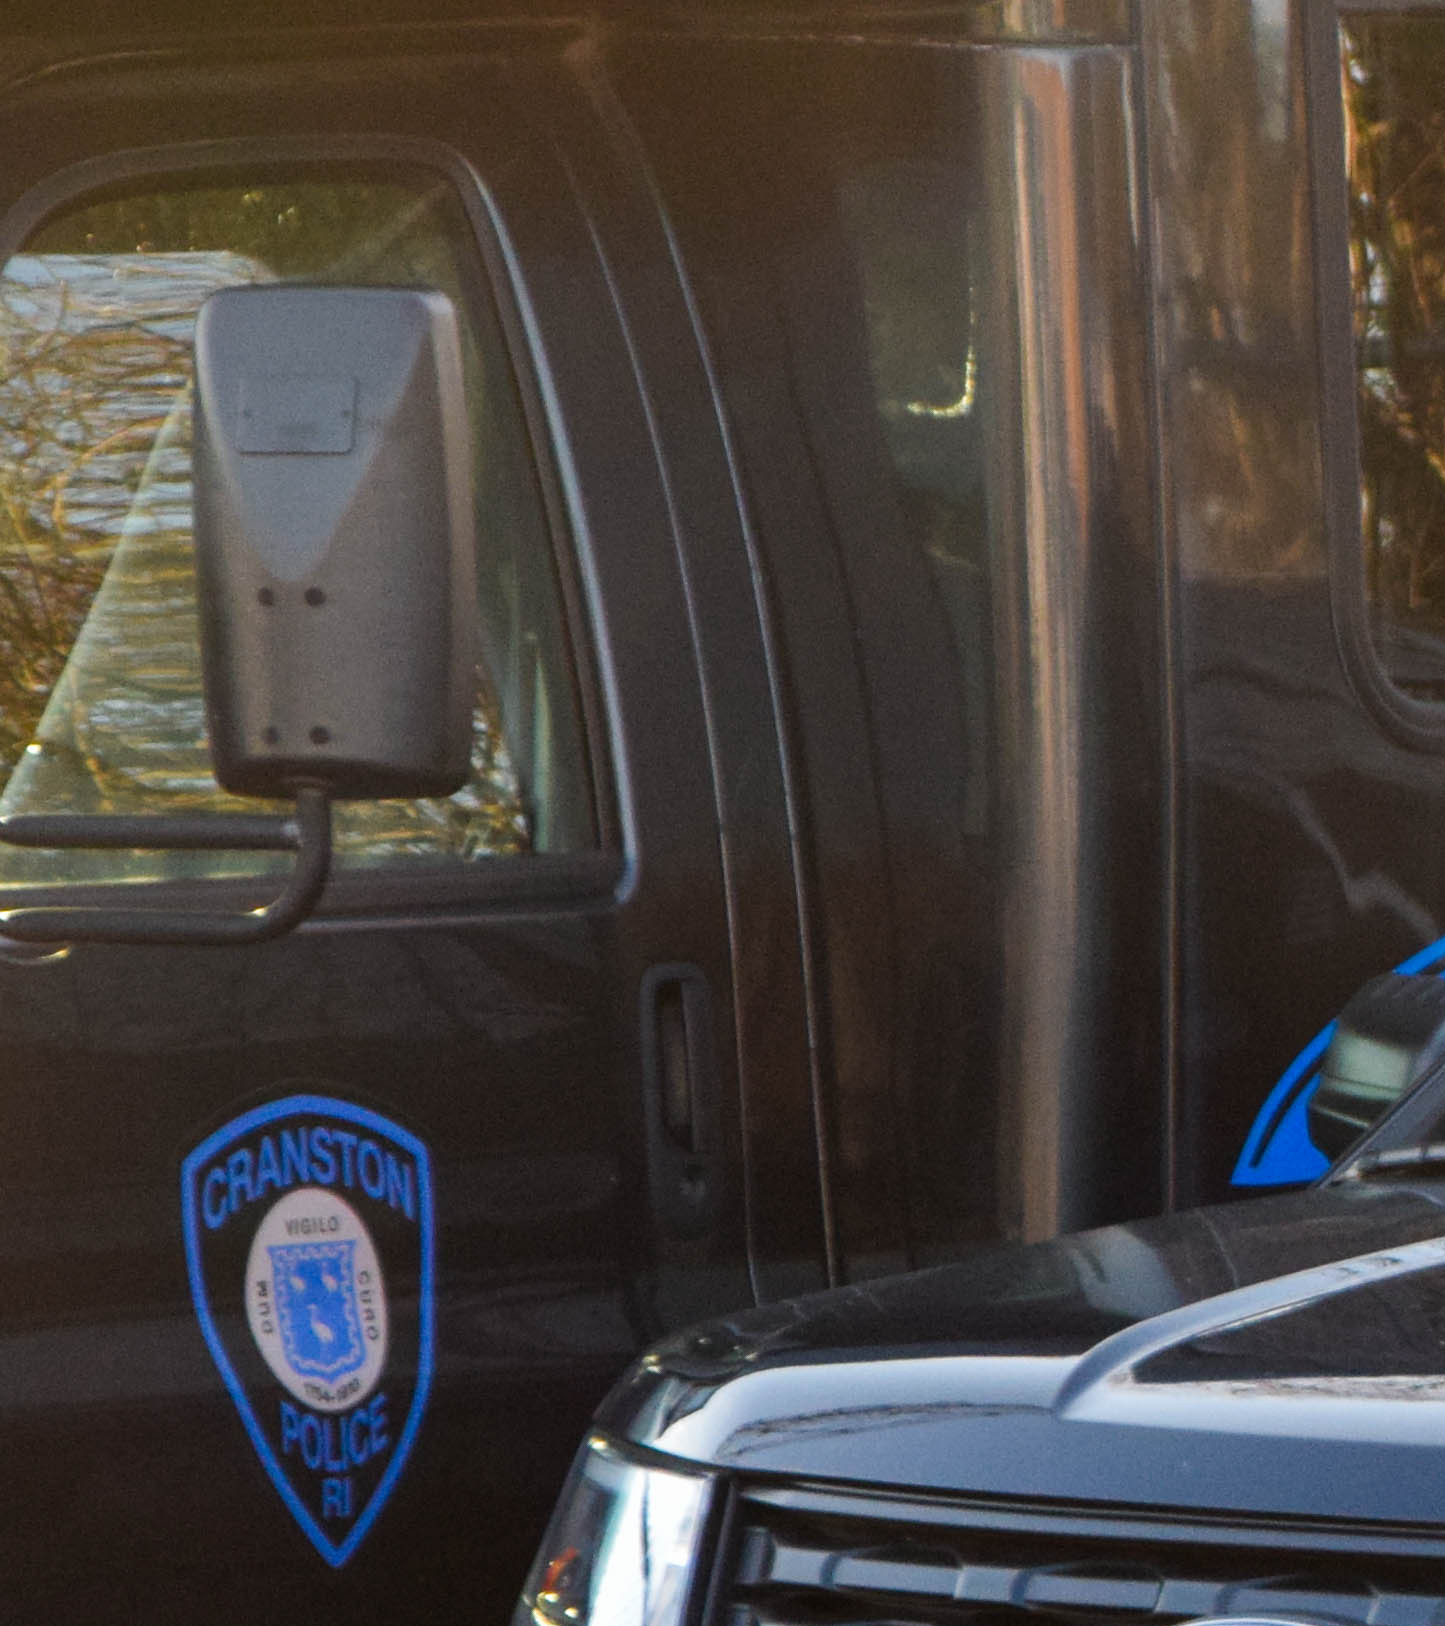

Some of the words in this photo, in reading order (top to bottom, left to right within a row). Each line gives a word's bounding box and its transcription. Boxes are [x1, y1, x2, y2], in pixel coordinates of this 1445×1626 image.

[202, 1127, 416, 1230] CRANSTON
[285, 1216, 341, 1236] VIGILO
[358, 1270, 380, 1342] CURO
[280, 1393, 389, 1472] POLICE
[322, 1478, 353, 1517] RI
